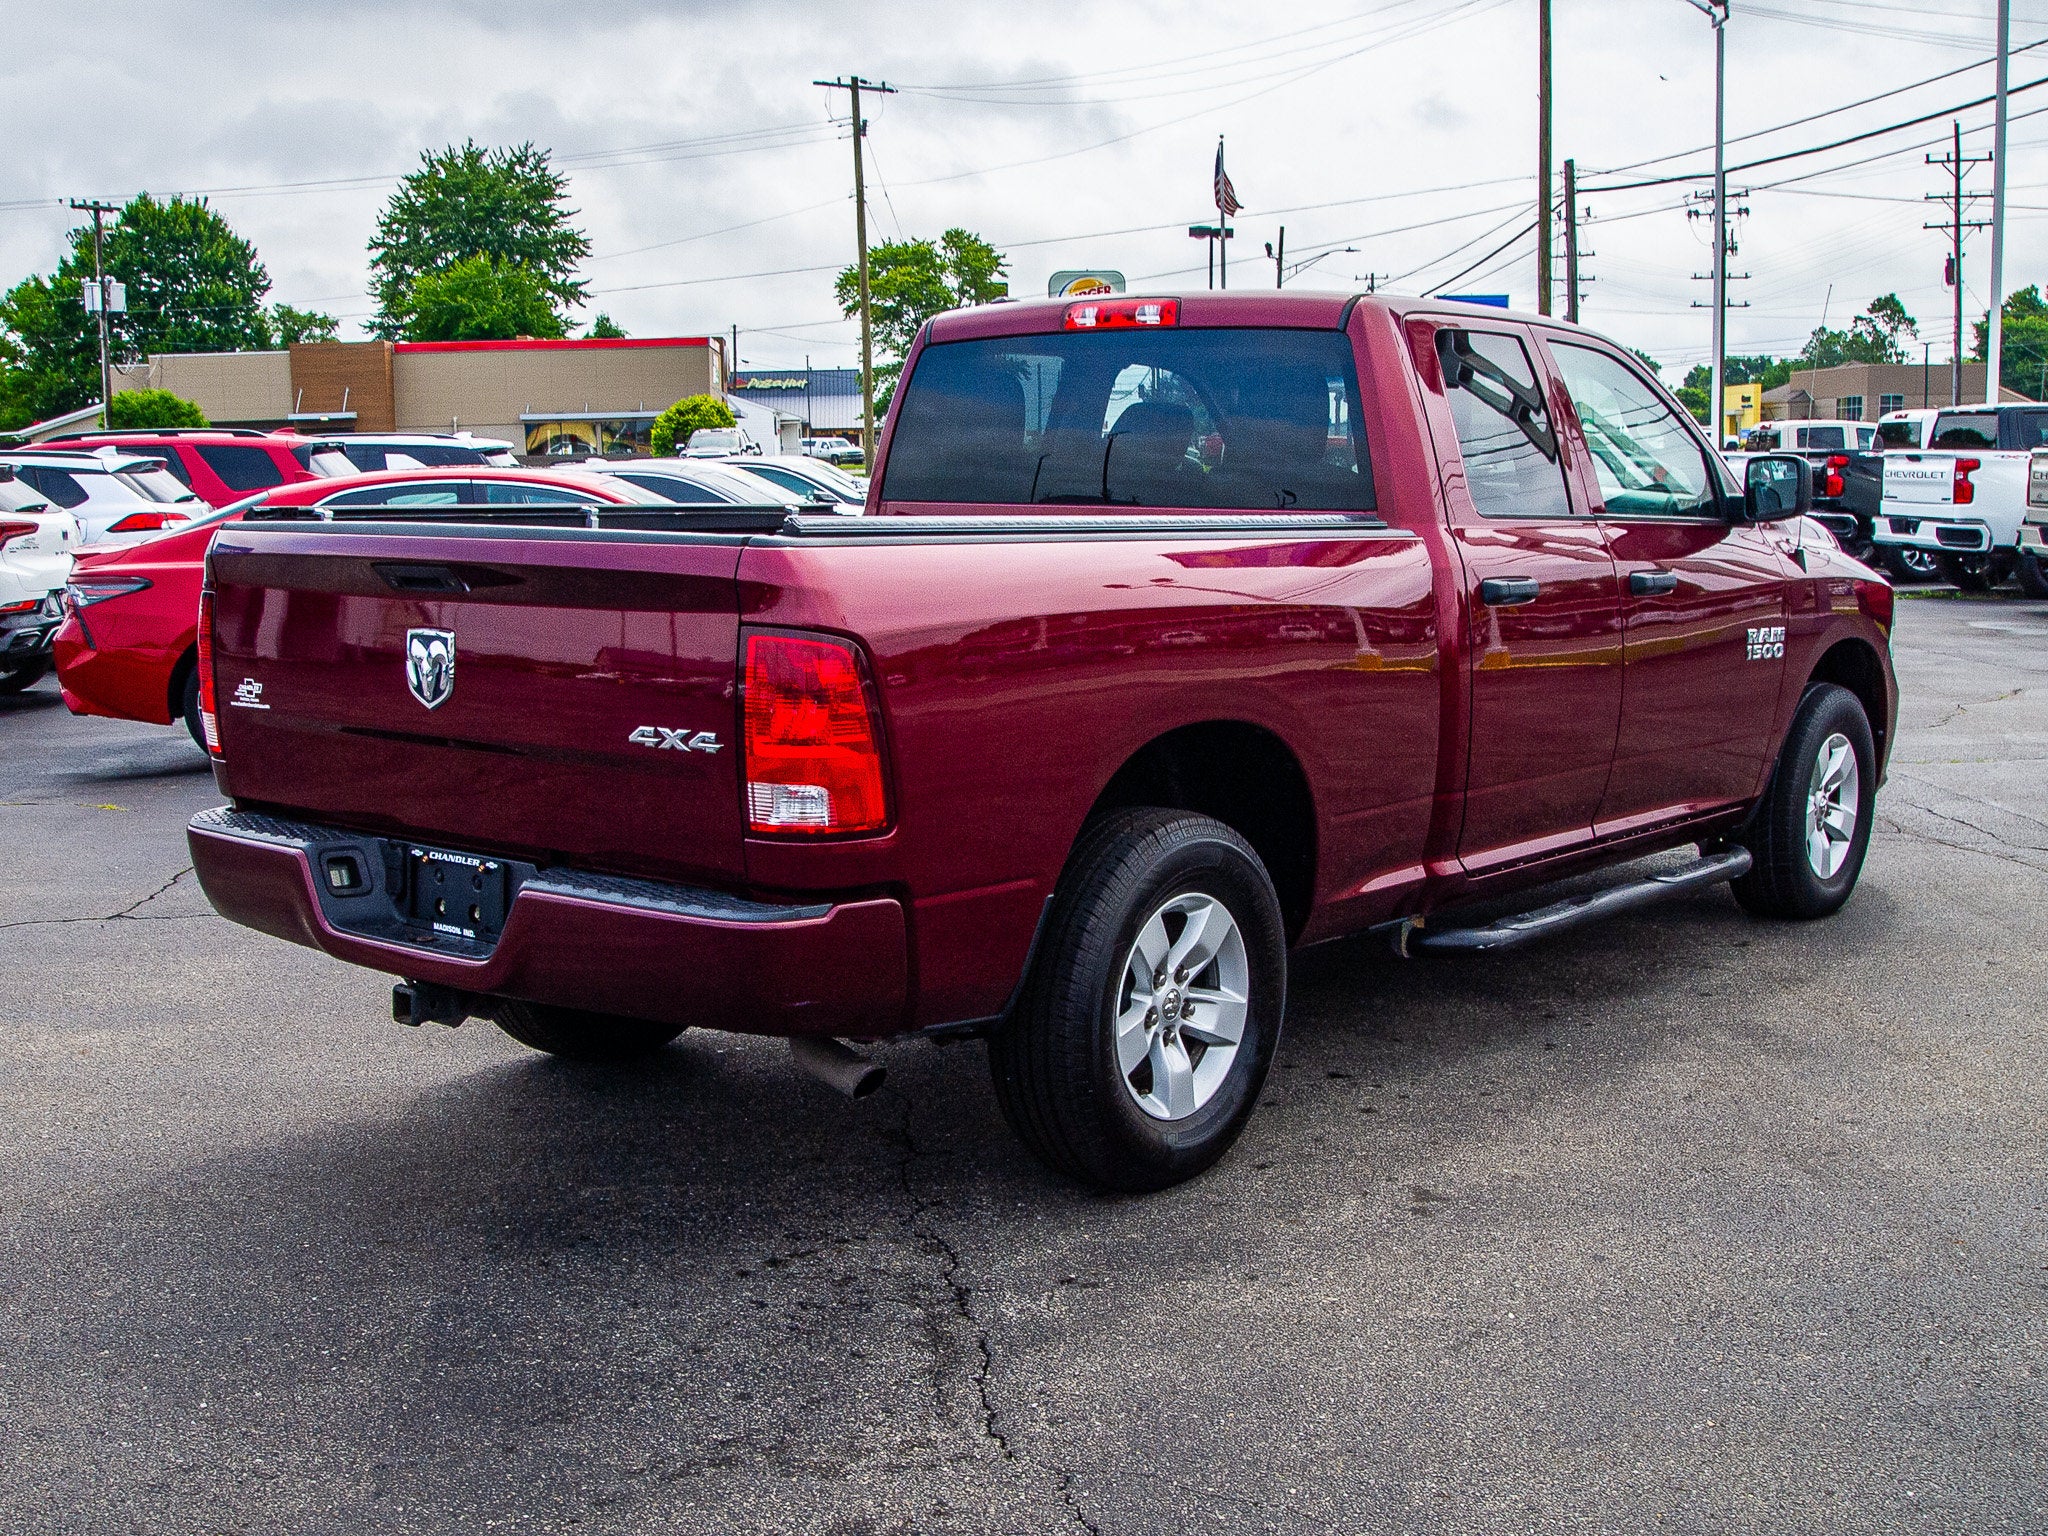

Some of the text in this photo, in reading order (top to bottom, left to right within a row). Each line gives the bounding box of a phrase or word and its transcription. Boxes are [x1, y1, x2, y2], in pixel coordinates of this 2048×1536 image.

[1884, 470, 1946, 480] CHEVROLET
[1747, 626, 1786, 643] RAM
[1746, 643, 1785, 661] 1500
[429, 851, 480, 867] CHANDLER
